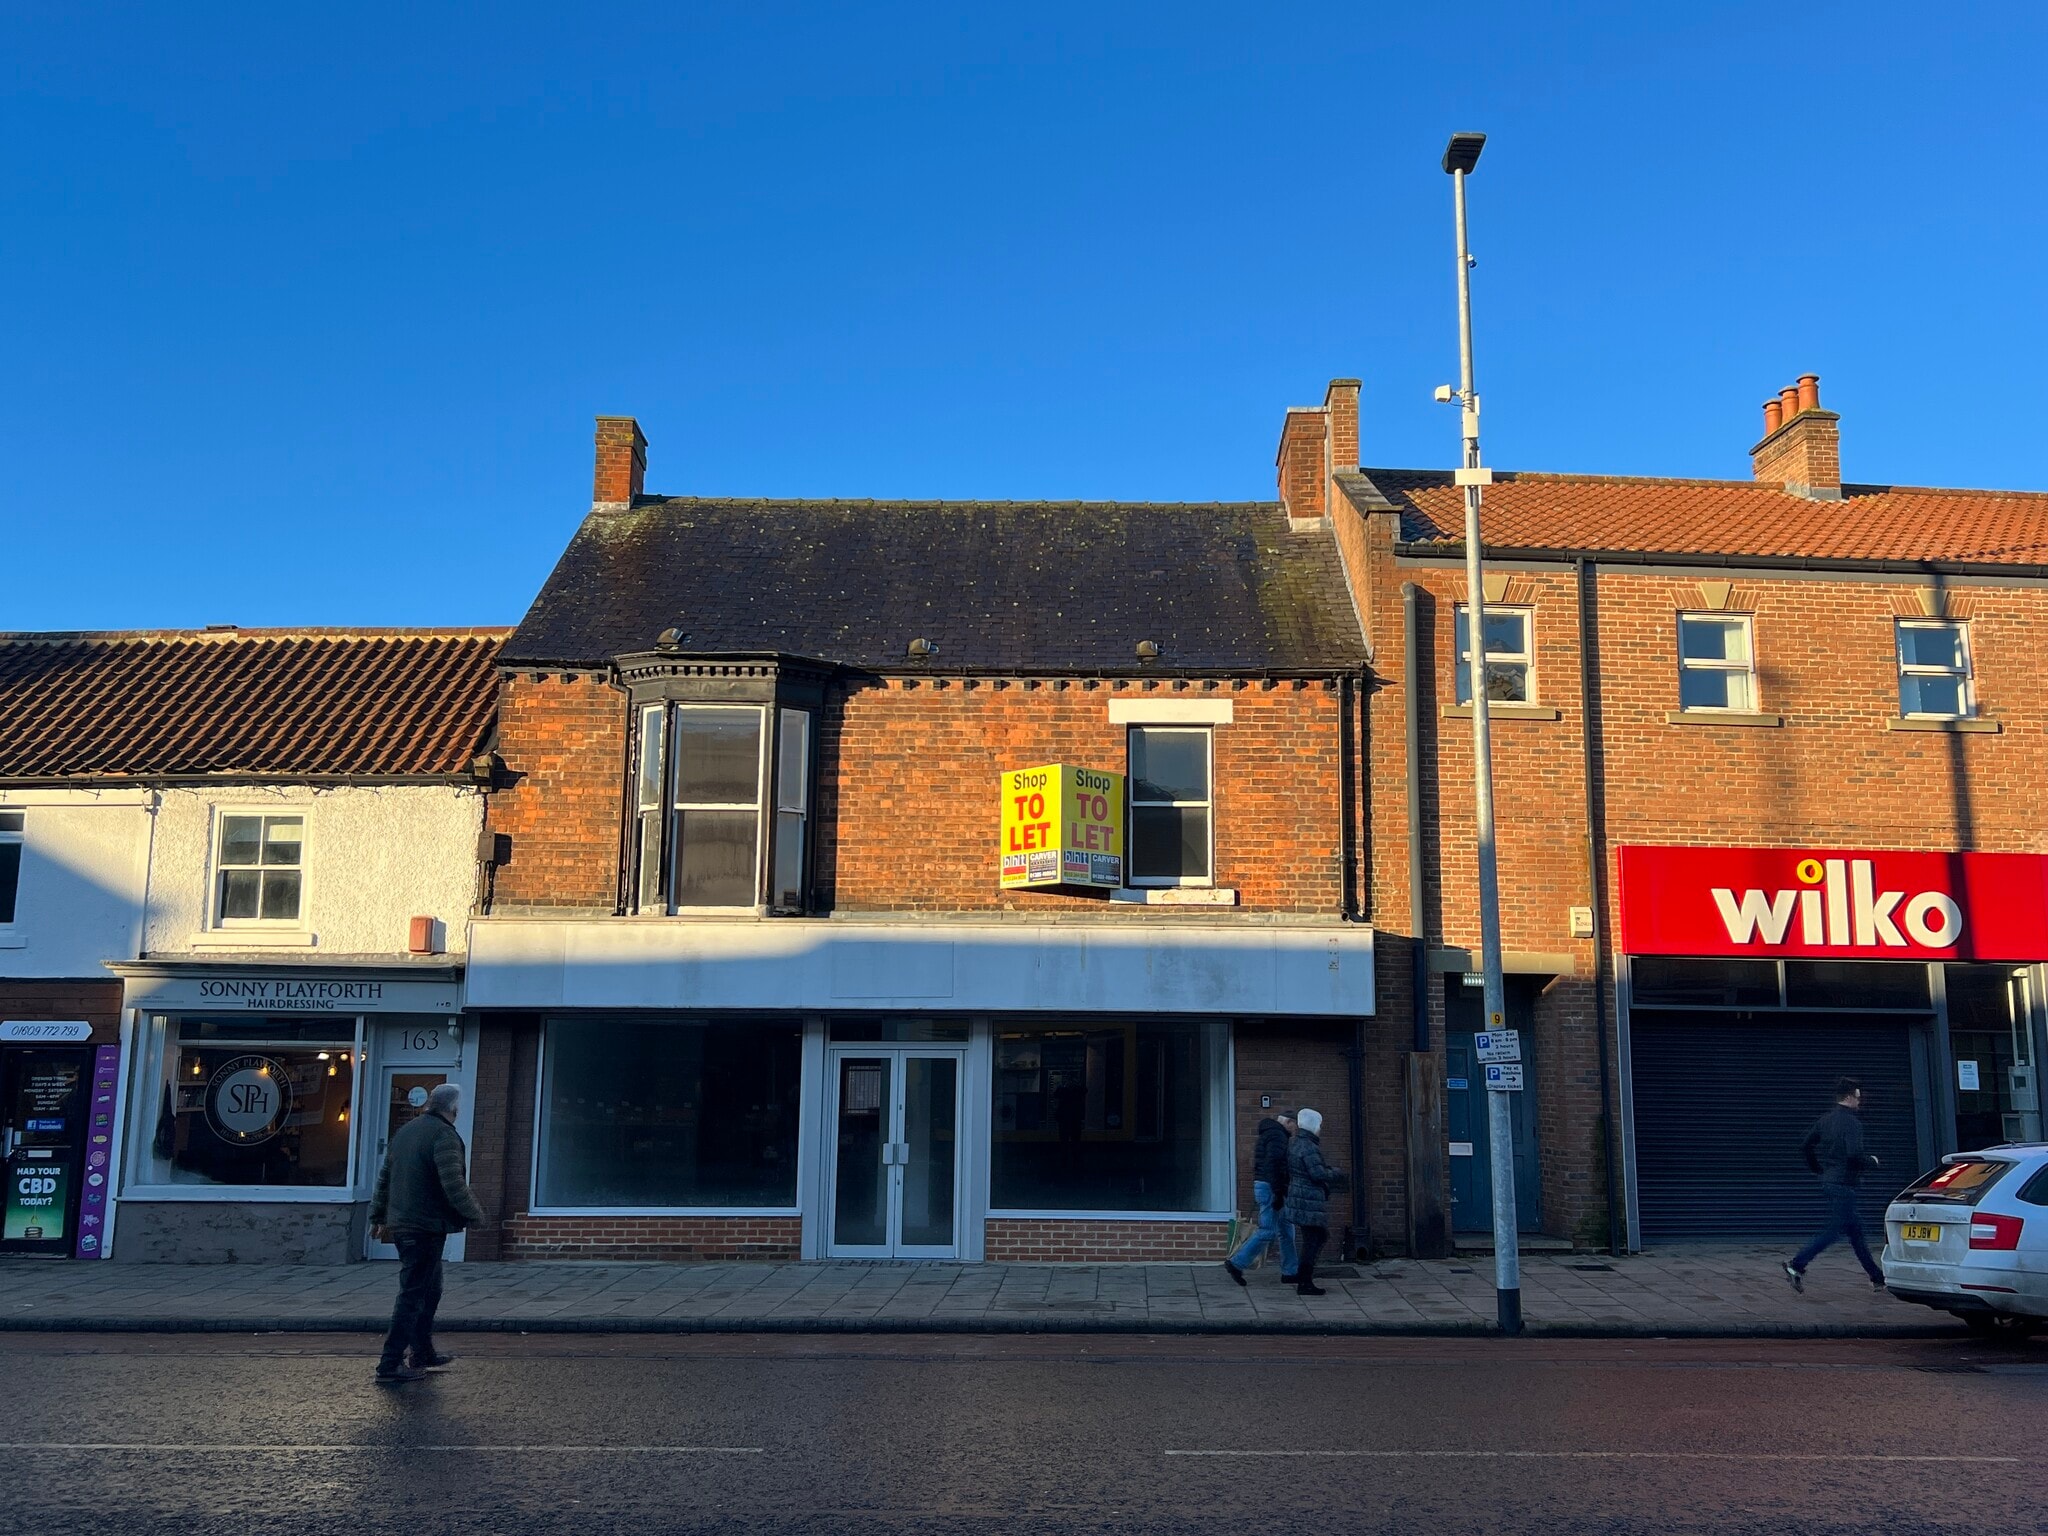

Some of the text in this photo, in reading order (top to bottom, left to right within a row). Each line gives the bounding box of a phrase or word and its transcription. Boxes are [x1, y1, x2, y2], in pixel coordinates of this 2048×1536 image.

[1014, 773, 1047, 790] Shop
[1076, 770, 1110, 794] Shop
[1014, 793, 1044, 820] TO
[1076, 793, 1108, 822] TO
[1010, 822, 1050, 851] LET
[1072, 822, 1114, 851] LET
[1030, 851, 1056, 860] CARVER
[1092, 854, 1119, 864] CARVER
[1711, 859, 1964, 948] wilko
[200, 981, 382, 999] SONNY PLAYFORTH
[248, 999, 334, 1009] HAIRDRESSING
[1495, 1014, 1500, 1024] 9
[11, 1026, 79, 1036] 01609 772 799
[401, 1030, 439, 1050] 163
[1480, 1037, 1487, 1047] P
[212, 1058, 288, 1089] SONNY PLAYORTH
[1490, 1069, 1498, 1079] P
[228, 1084, 269, 1114] SPH
[19, 1178, 56, 1194] CBD
[20, 1197, 53, 1206] TODAY?
[1918, 1227, 1932, 1239] JBW
